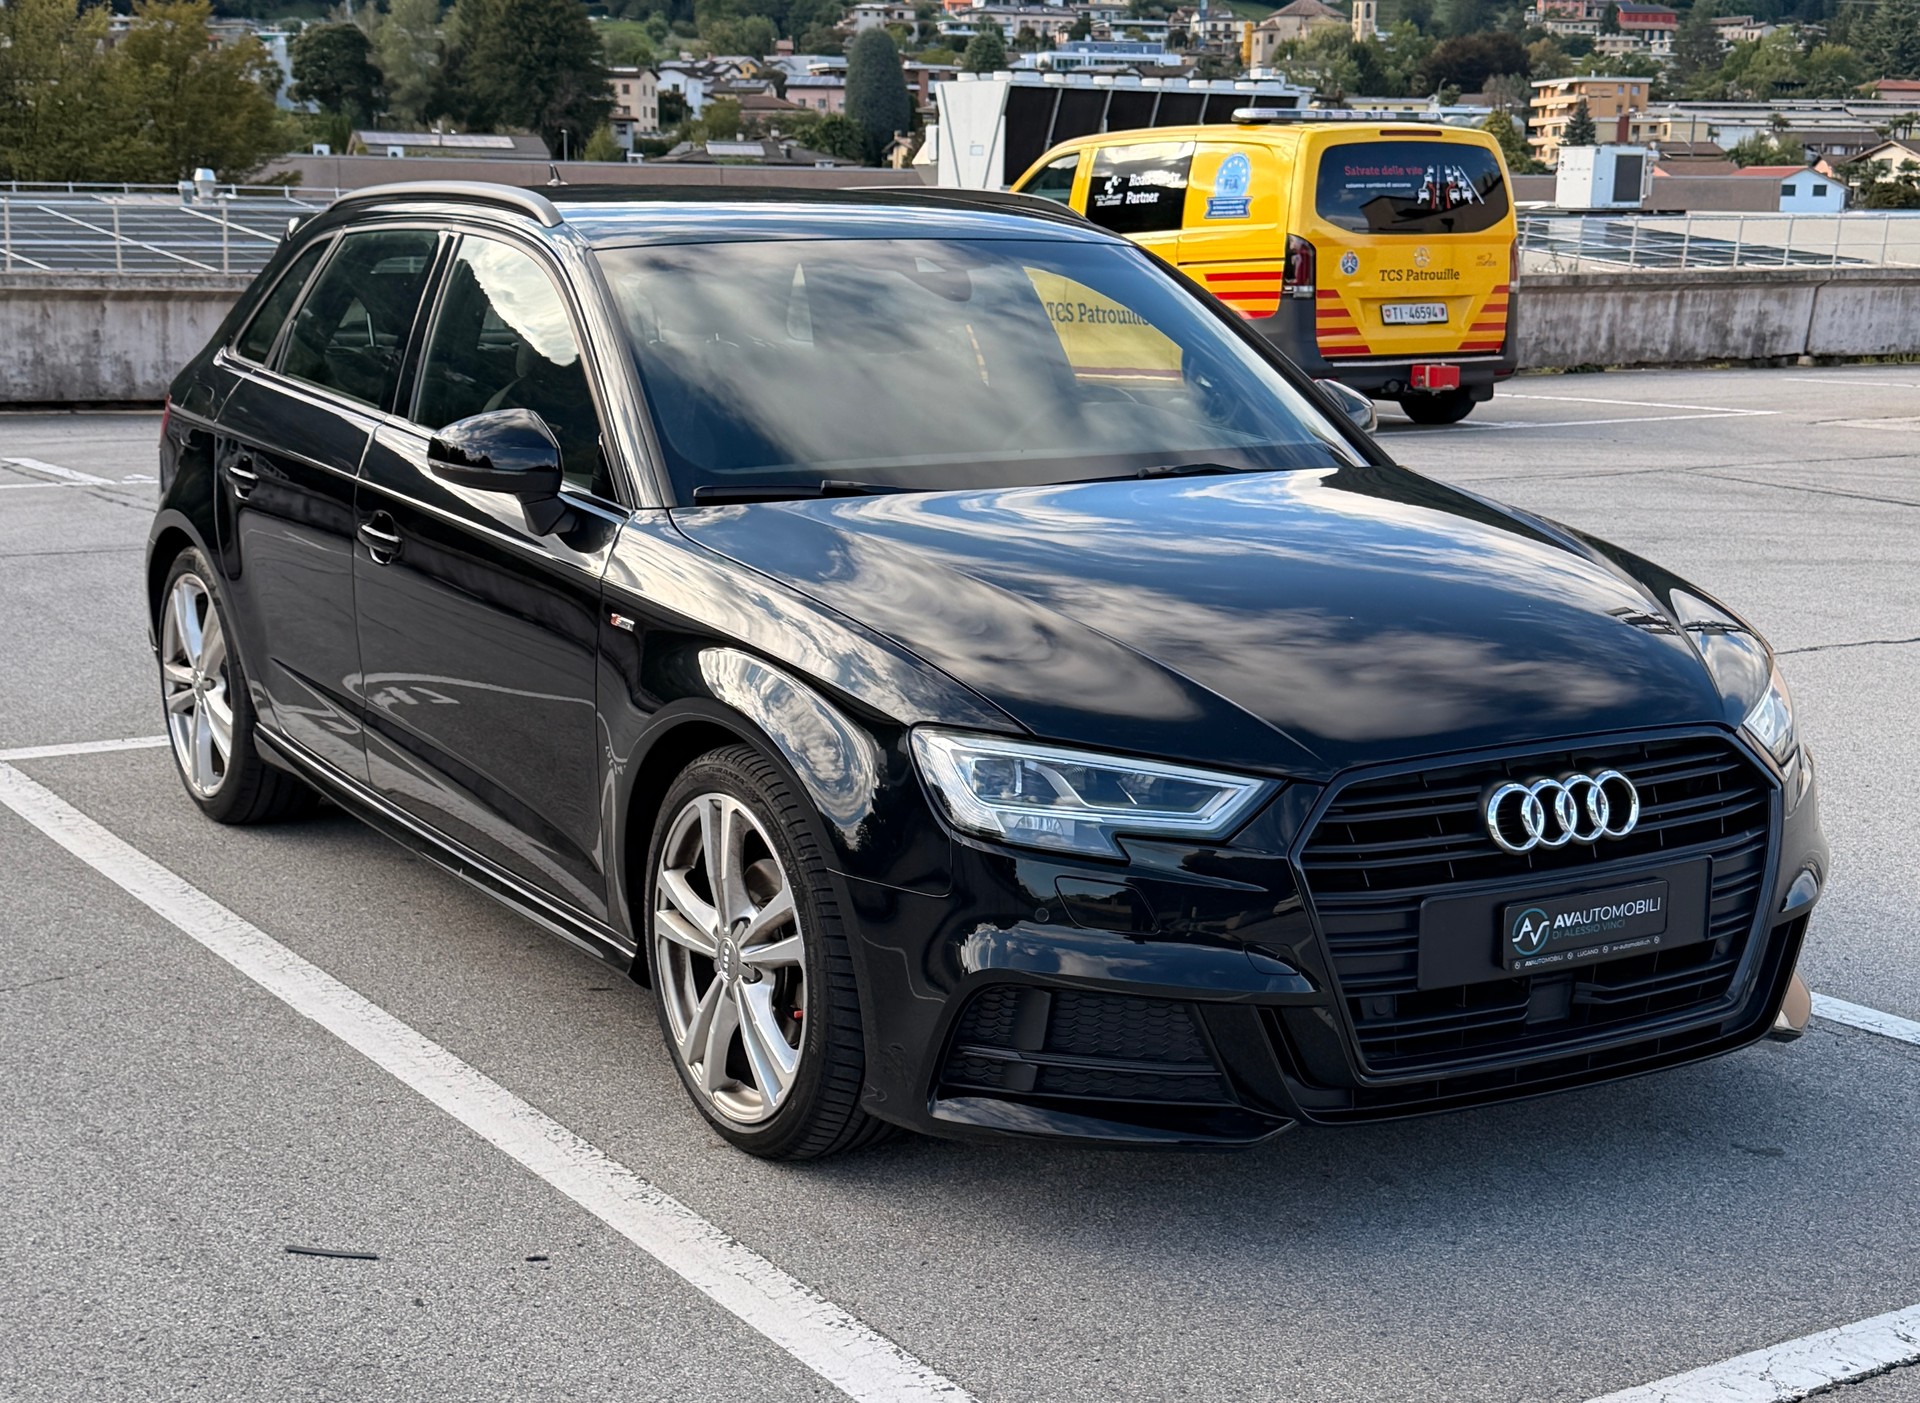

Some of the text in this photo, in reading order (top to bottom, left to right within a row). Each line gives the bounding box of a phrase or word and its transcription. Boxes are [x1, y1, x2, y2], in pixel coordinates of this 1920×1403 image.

[1344, 165, 1424, 176] Salvate delle vite
[1125, 191, 1160, 205] Partner
[1379, 268, 1460, 282] TCS Patrouille
[1046, 301, 1074, 322] TCS
[1553, 897, 1661, 929] AVAUTOMOBILI
[1552, 919, 1626, 940] DI ALESSIO VINCI
[1576, 948, 1599, 958] LUGANO
